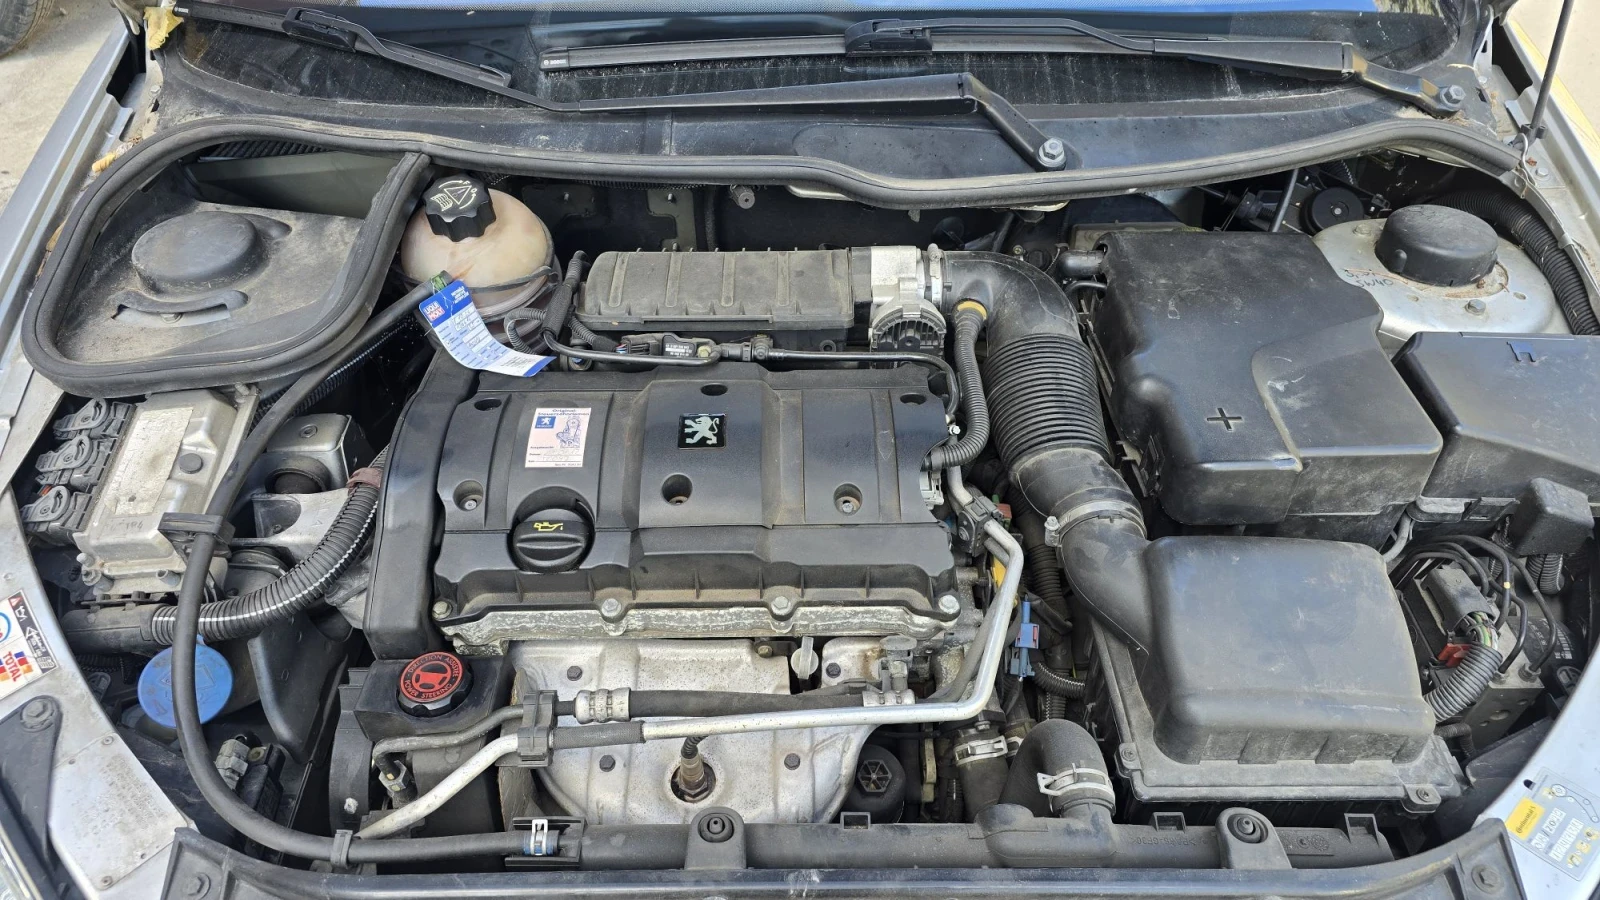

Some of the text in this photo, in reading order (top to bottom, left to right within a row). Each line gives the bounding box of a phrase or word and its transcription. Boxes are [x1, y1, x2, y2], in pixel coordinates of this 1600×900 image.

[424, 301, 440, 315] LIQUI
[428, 307, 444, 320] MOLY
[3, 651, 22, 682] TOTAL
[408, 654, 442, 672] DIRECTION
[405, 680, 452, 698] POWER STEERING
